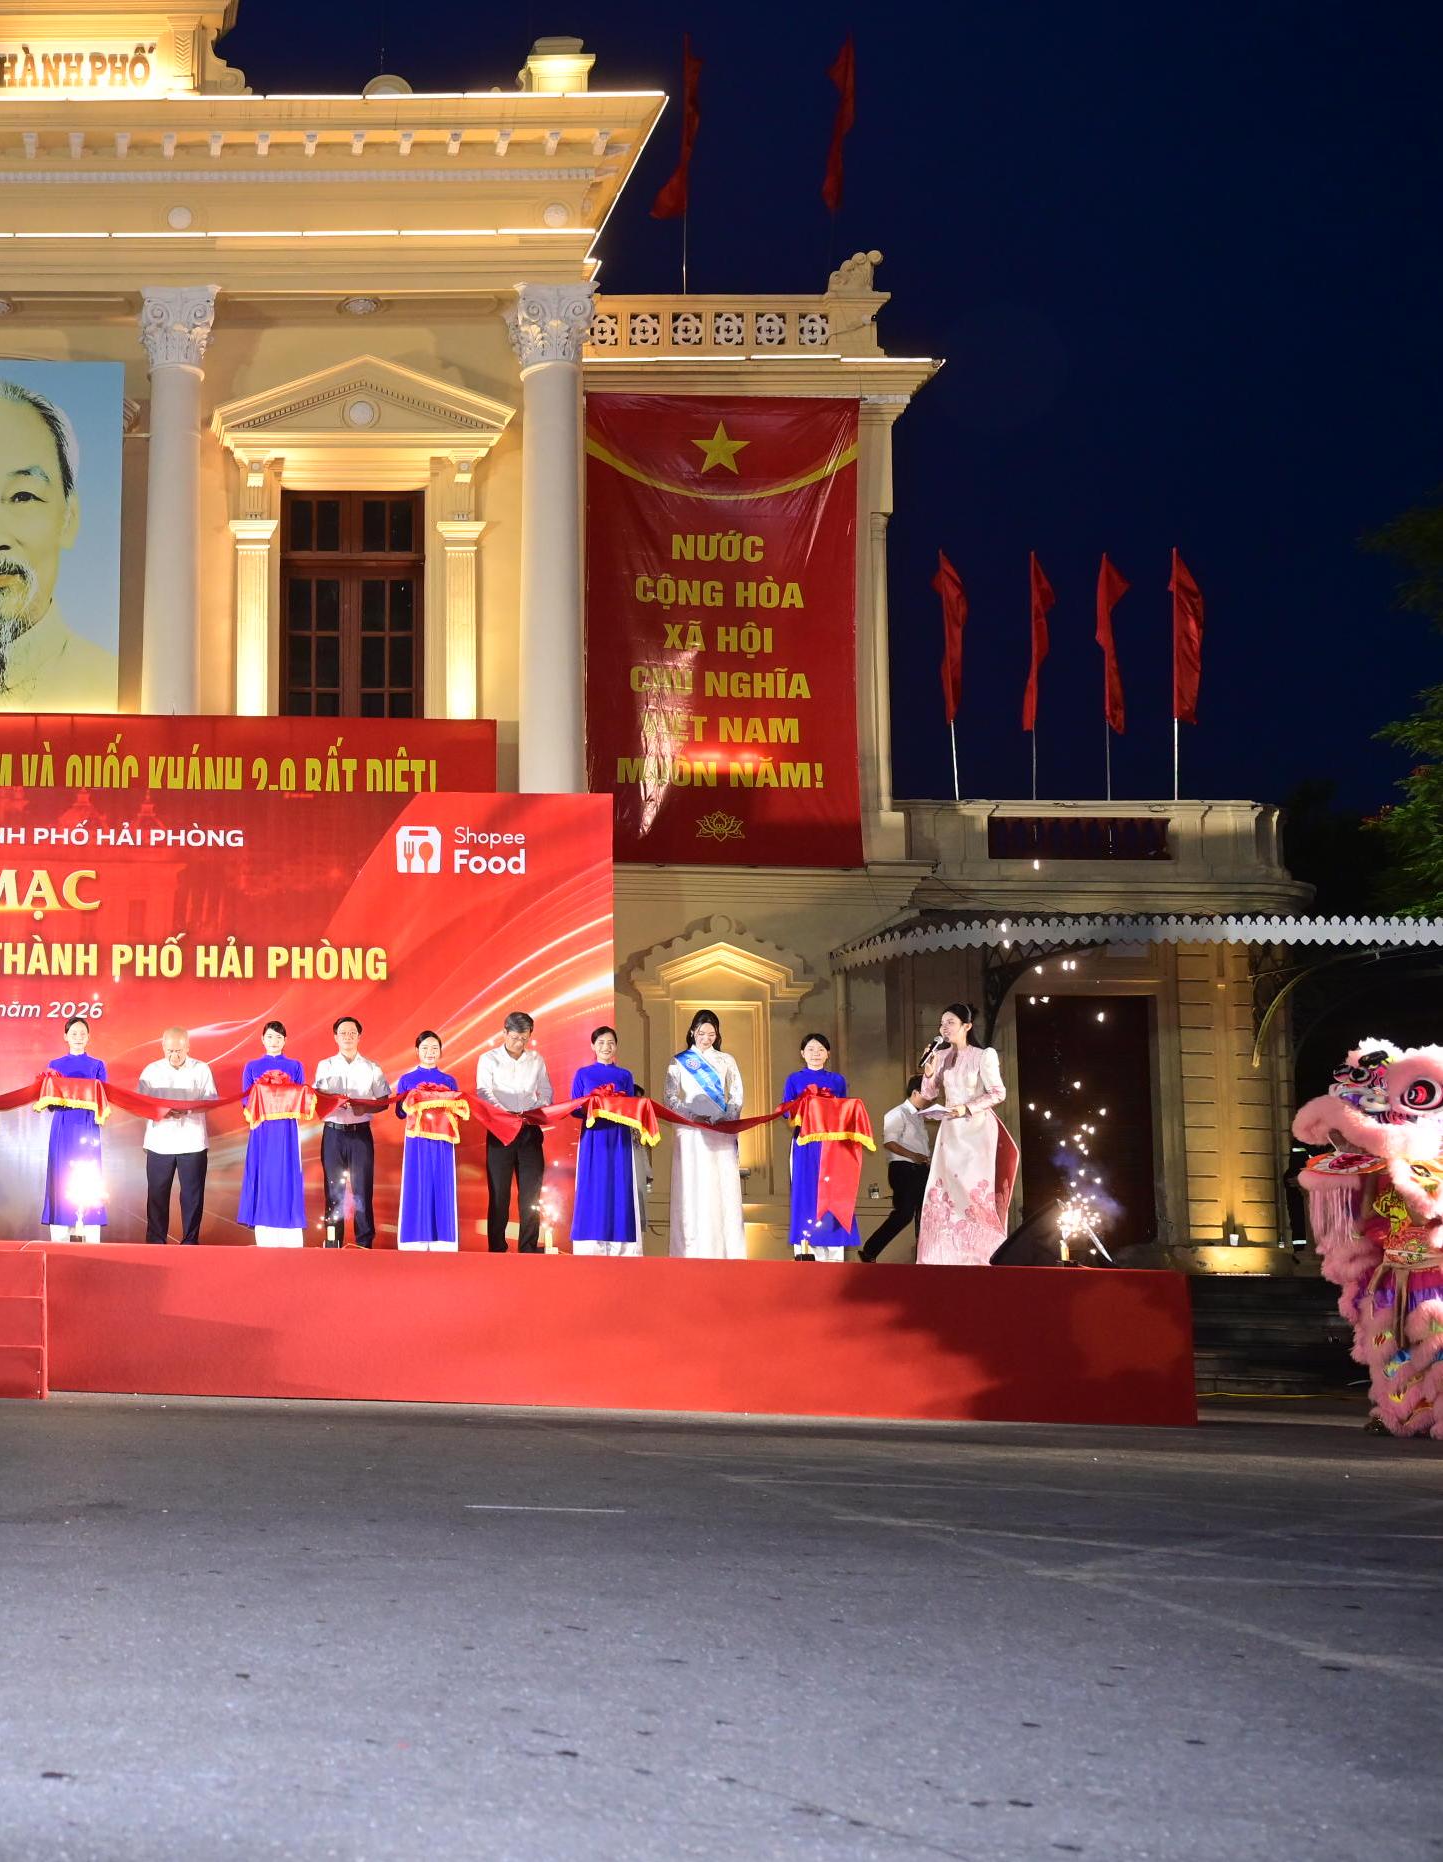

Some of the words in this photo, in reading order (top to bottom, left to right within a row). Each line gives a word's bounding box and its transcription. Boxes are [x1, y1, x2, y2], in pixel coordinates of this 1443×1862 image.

[89, 42, 156, 88] PHỐ
[672, 530, 764, 563] NƯỚC
[635, 573, 723, 610] CỘNG
[736, 575, 804, 609] HÒA
[663, 620, 706, 652] XÃ
[718, 621, 773, 659] HỘI
[705, 667, 811, 699] NGHĨA
[719, 717, 800, 744] NAM
[21, 741, 55, 787] VÀ
[148, 743, 242, 790] KHÁNH
[730, 757, 824, 788] NĂM!
[34, 820, 89, 846] PHỐ
[96, 822, 141, 846] HẢI
[150, 823, 244, 847] PHÒNG
[454, 826, 525, 849] Shopee
[454, 849, 526, 874] Food
[111, 932, 186, 978] PHỐ
[196, 936, 253, 979] HẢI
[267, 938, 388, 981] PHÒNG
[46, 1001, 103, 1019] 2026
